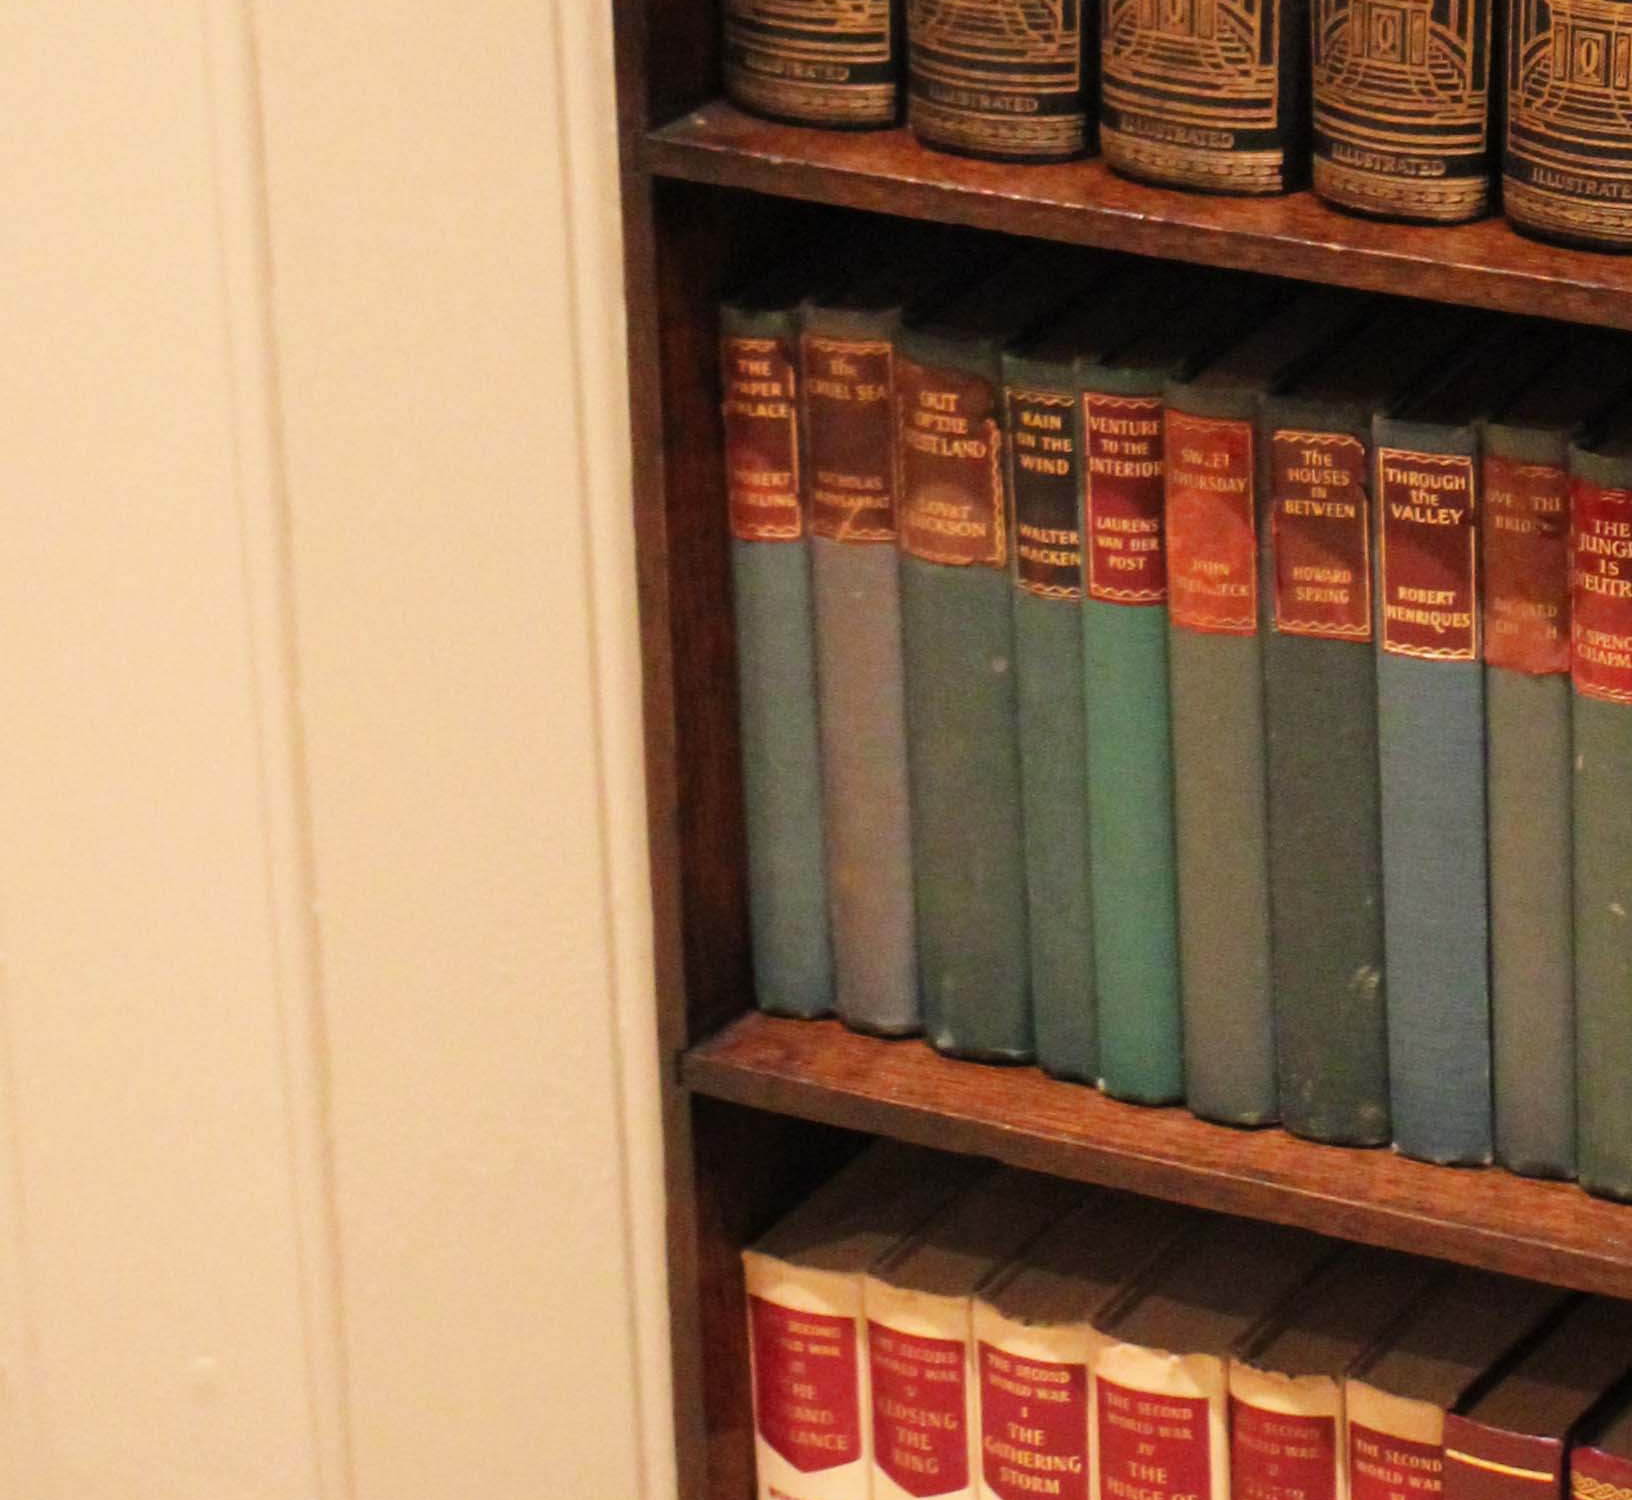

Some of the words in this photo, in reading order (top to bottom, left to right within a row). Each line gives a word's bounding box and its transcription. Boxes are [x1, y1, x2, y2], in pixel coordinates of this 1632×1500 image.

[1022, 411, 1062, 430] RAIN
[1090, 418, 1160, 436] VENTURE
[1041, 435, 1073, 453] THE
[1102, 439, 1120, 455] TO
[1124, 440, 1149, 455] THE
[1020, 455, 1070, 476] WIND
[1301, 450, 1333, 467] The
[1090, 459, 1163, 478] INTERIOR
[1288, 467, 1351, 486] HOUSES
[1385, 468, 1465, 490] THROUGH
[1312, 487, 1326, 498] IN
[1410, 489, 1439, 507] the
[1284, 499, 1355, 519] BETWEEN
[1391, 503, 1463, 525] VALLEY
[1097, 516, 1158, 533] LAURENS
[1592, 520, 1631, 538] THE
[1019, 525, 1078, 545] WALTER
[1130, 538, 1159, 552] DER
[1108, 555, 1147, 570] POST
[1293, 566, 1352, 584] HOWARD
[1296, 587, 1350, 604] SPRING
[1398, 586, 1456, 606] ROBERT
[1386, 605, 1471, 634] HENRIQUES
[897, 1425, 933, 1451] THE
[1007, 1424, 1045, 1447] THE
[894, 1450, 940, 1475] RING
[1384, 1450, 1442, 1472] SECOND
[999, 1466, 1060, 1495] STORM
[1128, 1461, 1168, 1485] THE
[1409, 1475, 1442, 1492] WAR
